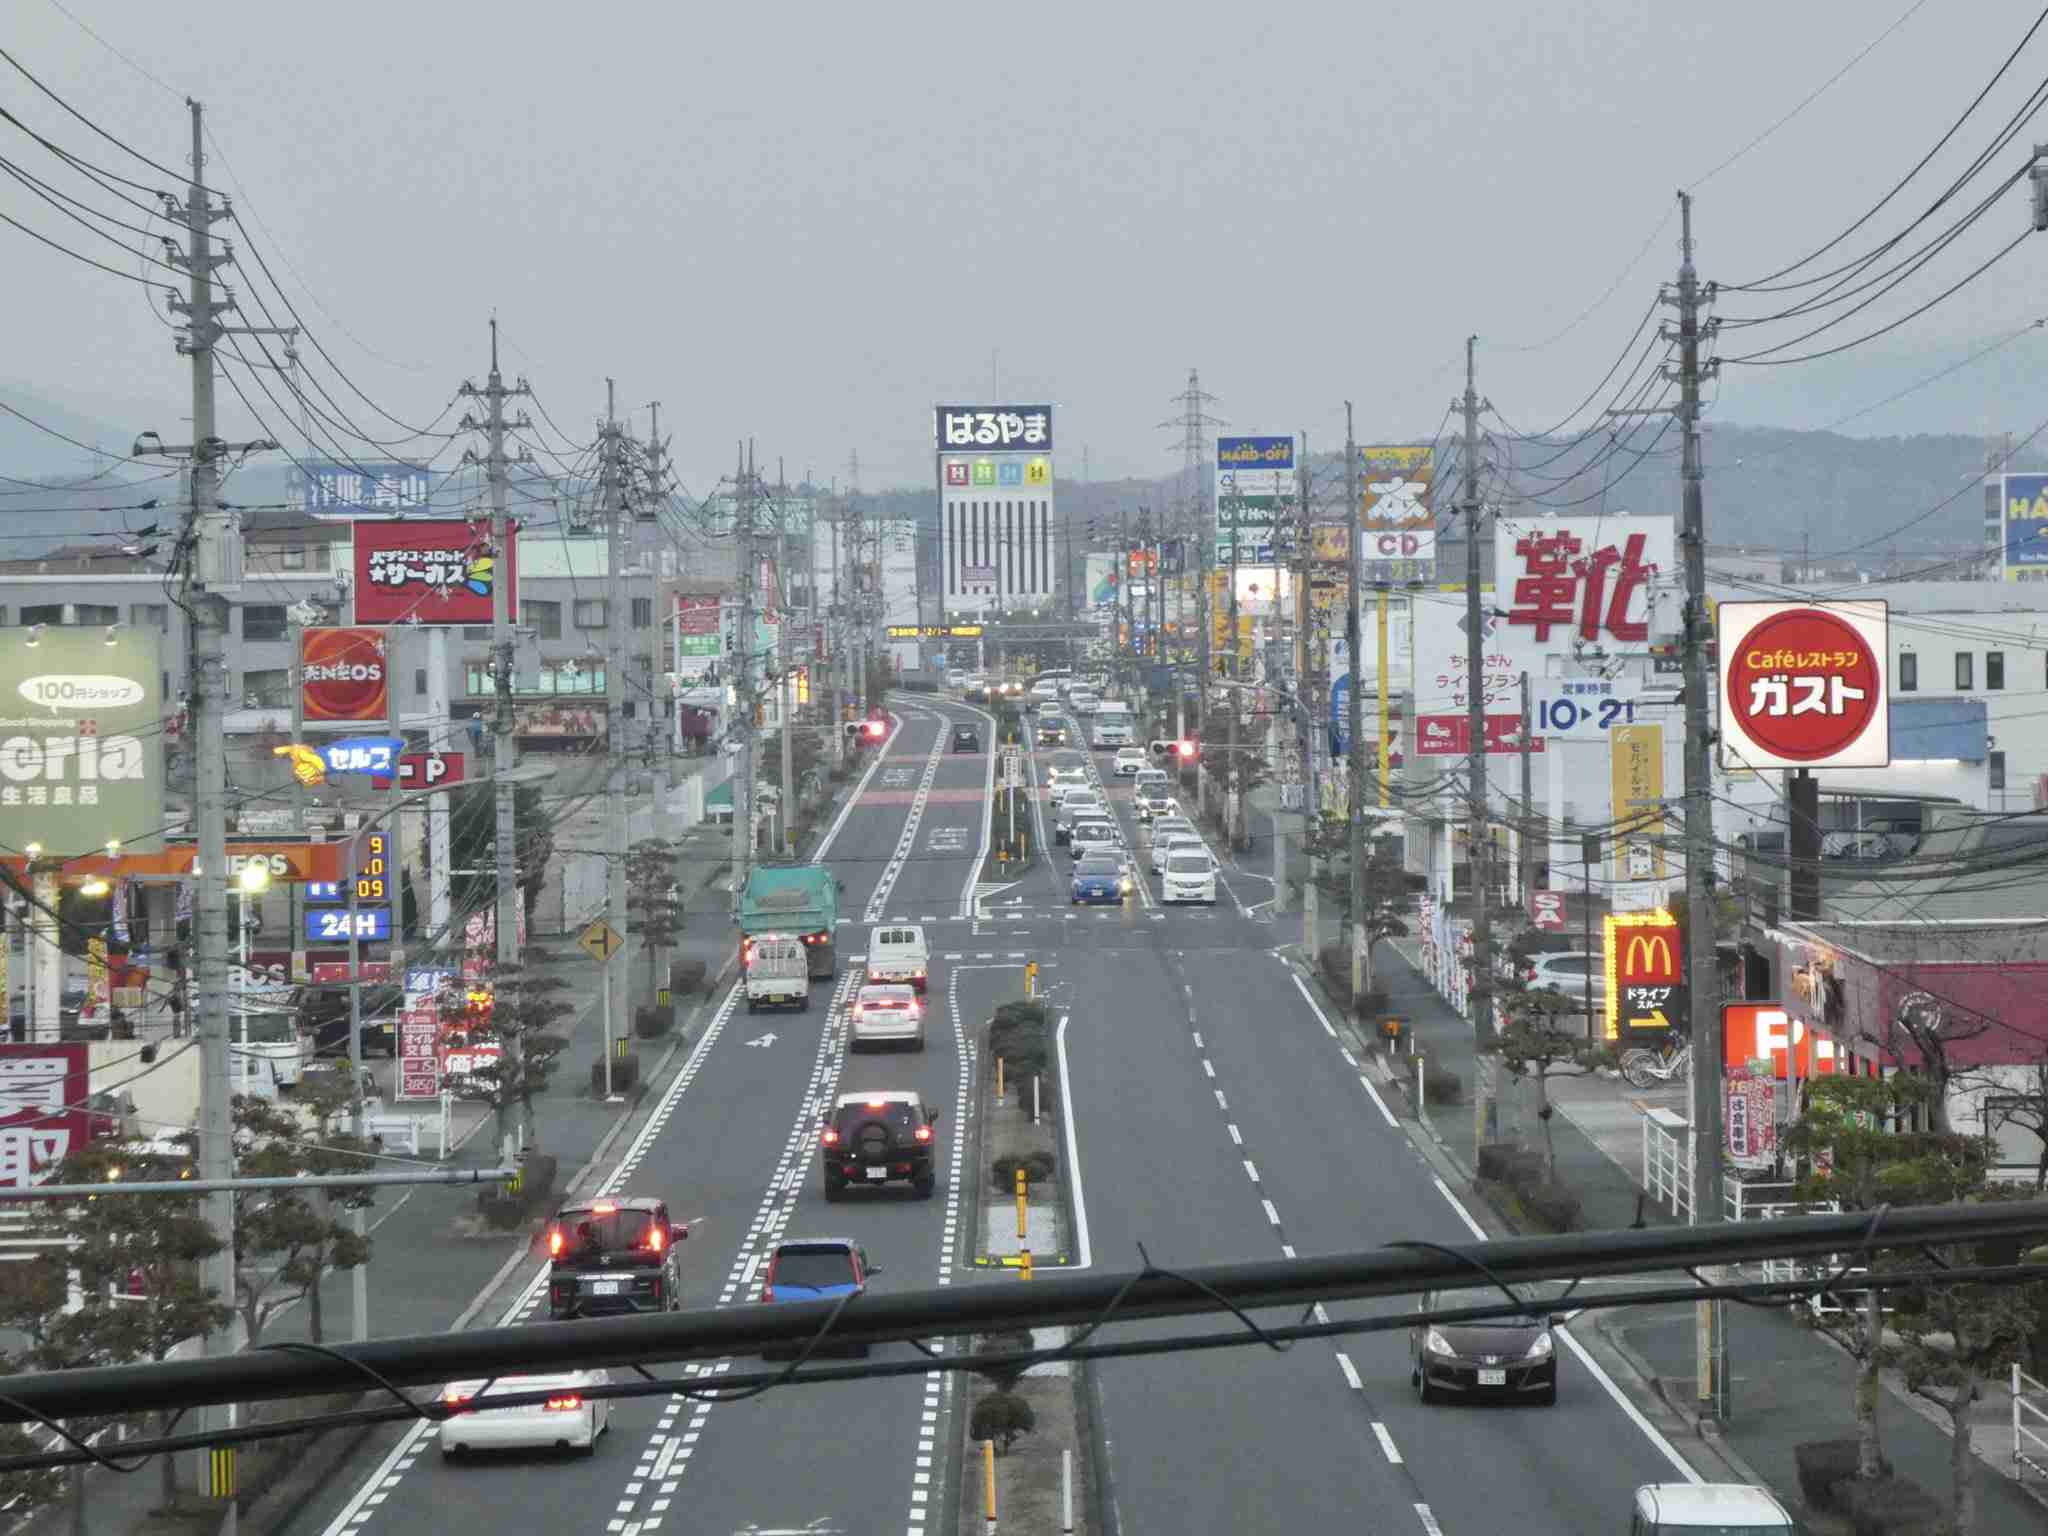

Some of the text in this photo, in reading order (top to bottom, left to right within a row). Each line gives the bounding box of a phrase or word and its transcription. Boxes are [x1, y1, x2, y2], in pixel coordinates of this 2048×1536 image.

[945, 413, 1047, 443] はるやま
[309, 473, 428, 506] 洋服の青山
[1368, 476, 1427, 523] 本
[1377, 533, 1418, 556] CD
[387, 563, 465, 584] サーカス
[1508, 530, 1656, 642] 靴
[36, 682, 131, 699] 100円ショップ
[1453, 693, 1511, 706] セター
[1750, 674, 1865, 716] ガスト
[328, 748, 390, 769] セルフ
[427, 758, 446, 783] P
[320, 914, 377, 936] 24H
[1627, 987, 1672, 1000] ドライブ
[1637, 1000, 1664, 1009] スルー
